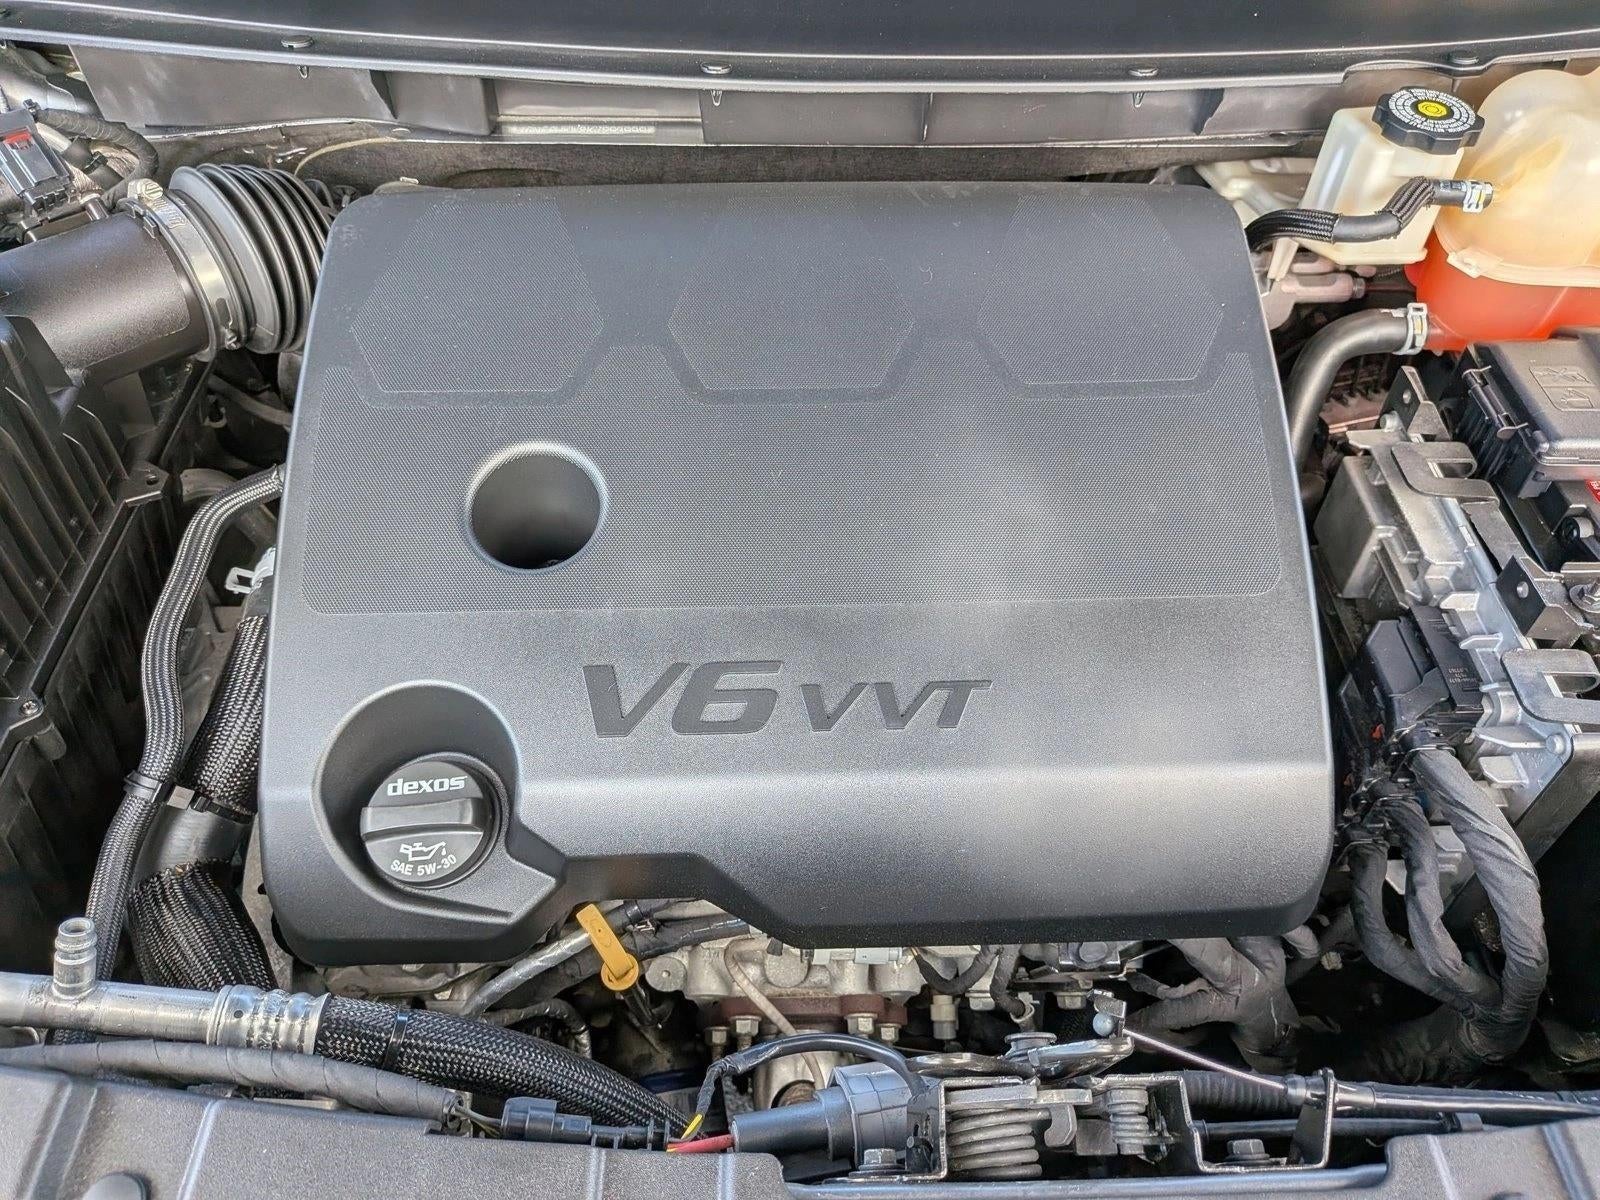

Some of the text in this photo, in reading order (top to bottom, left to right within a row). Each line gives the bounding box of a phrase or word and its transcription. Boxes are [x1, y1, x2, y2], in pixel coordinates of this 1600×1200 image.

[583, 660, 993, 737] V6 VVT
[387, 775, 468, 796] dexos
[390, 854, 457, 876] SAE 5W-30
